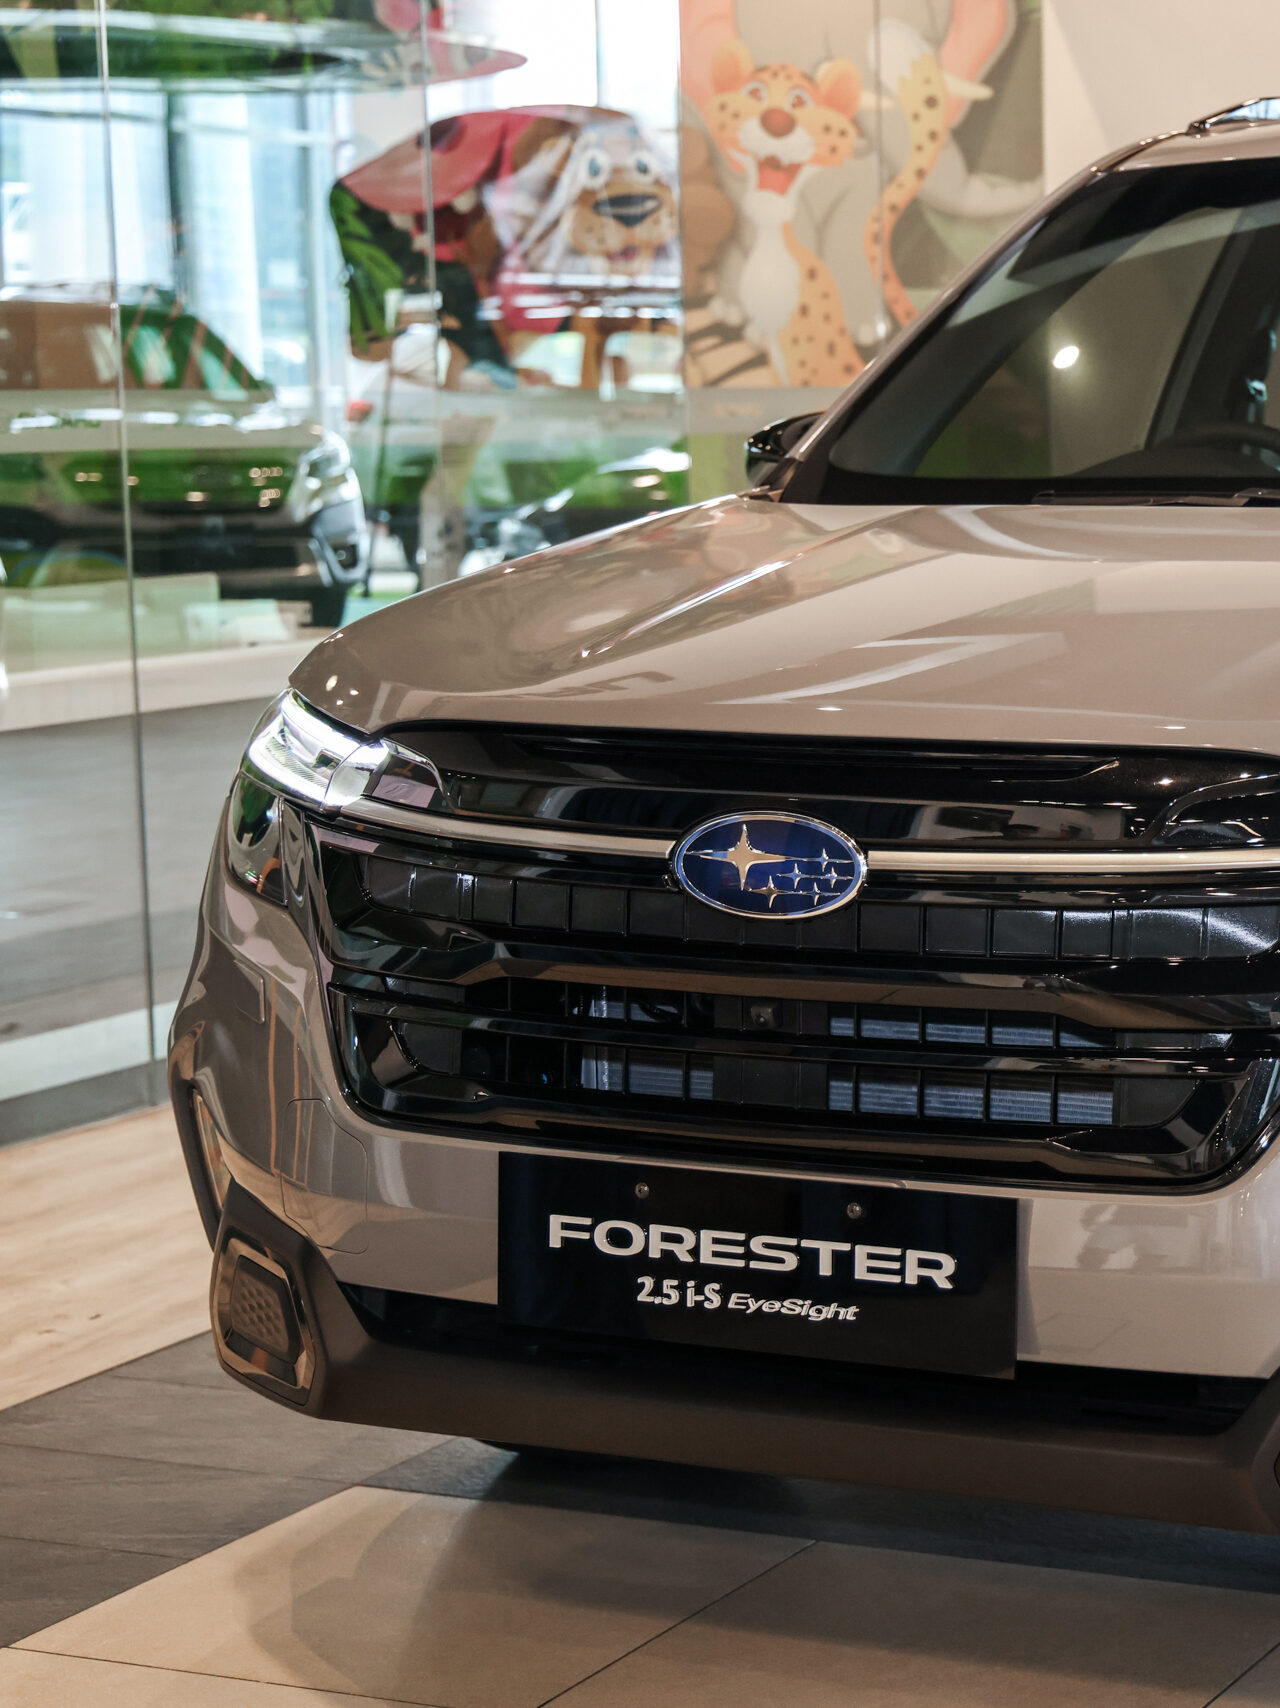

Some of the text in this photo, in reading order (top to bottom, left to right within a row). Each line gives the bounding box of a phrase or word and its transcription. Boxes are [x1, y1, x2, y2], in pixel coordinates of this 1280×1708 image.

[549, 1214, 956, 1289] FORESTER
[636, 1275, 860, 1322] 2.5 i-S EyeSight
